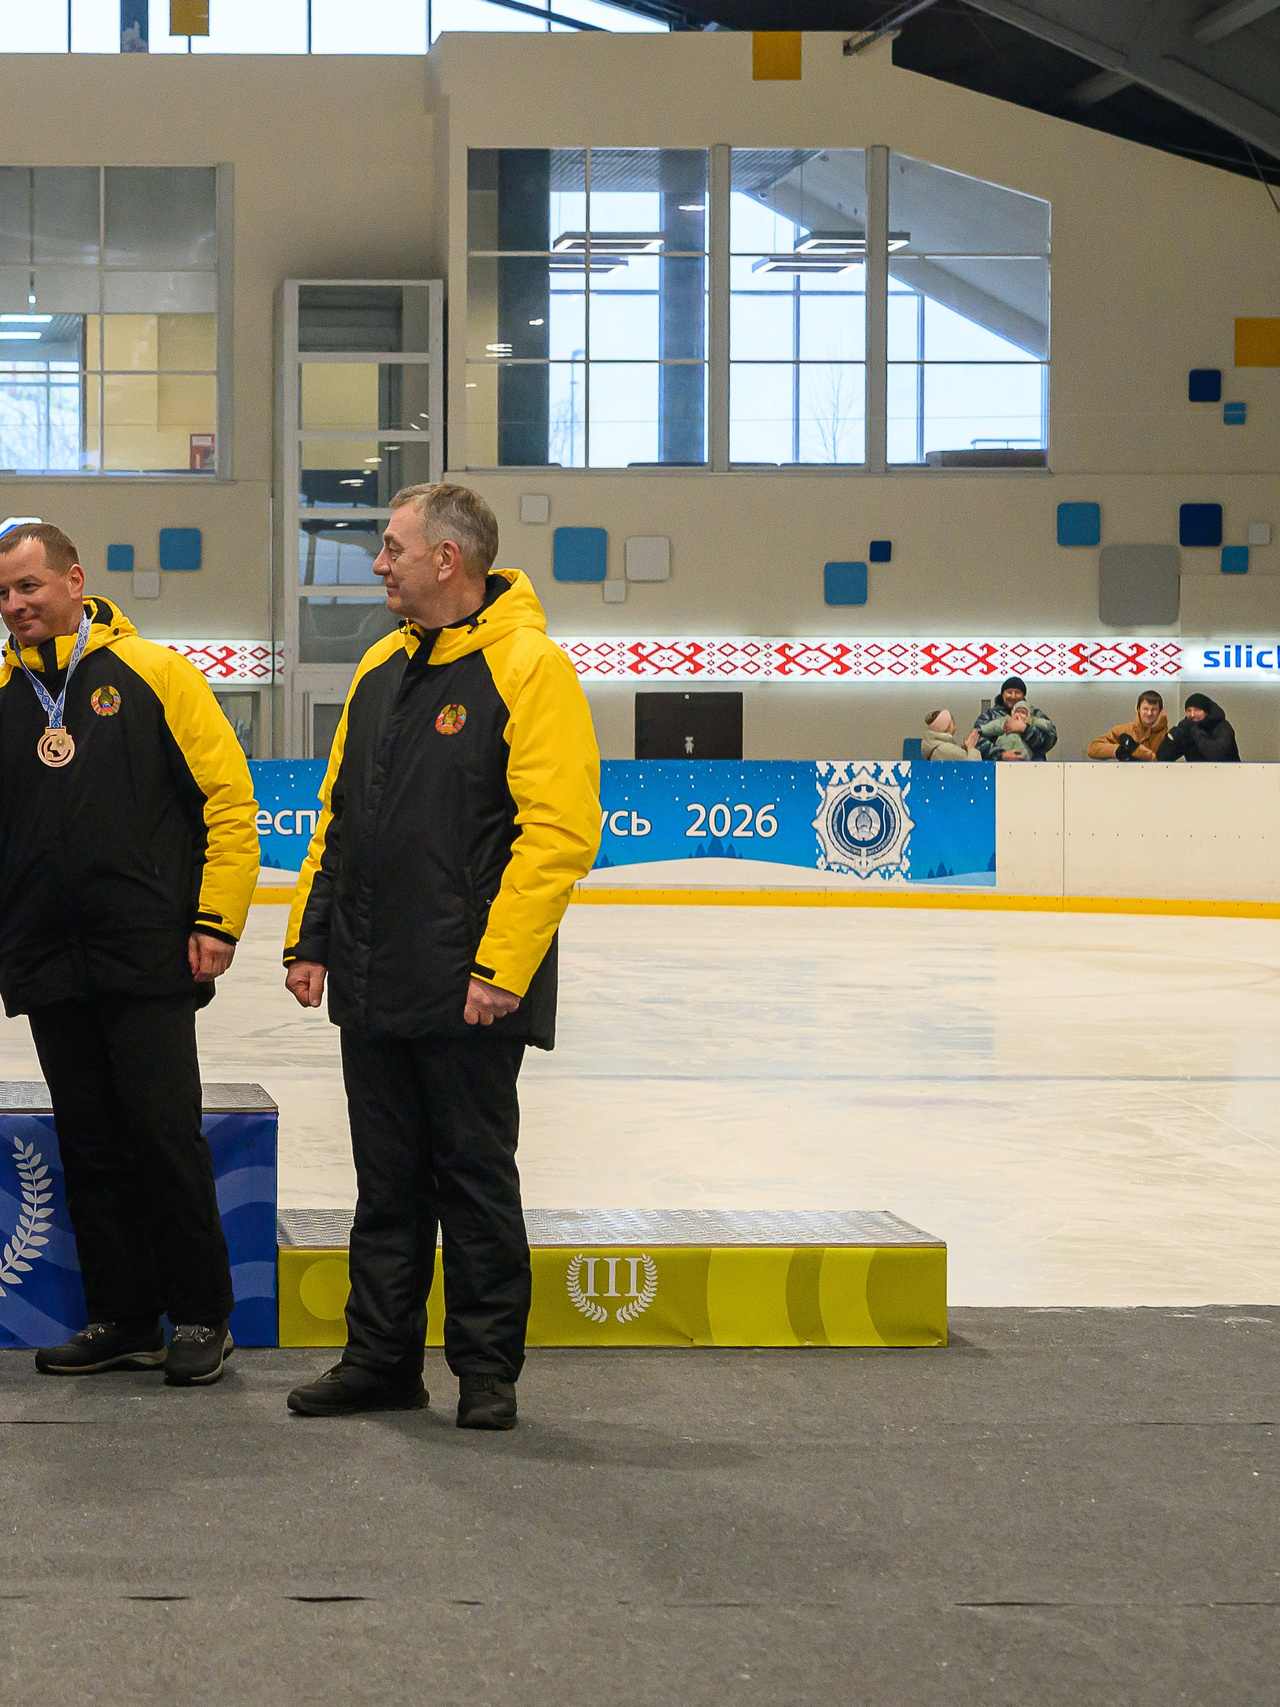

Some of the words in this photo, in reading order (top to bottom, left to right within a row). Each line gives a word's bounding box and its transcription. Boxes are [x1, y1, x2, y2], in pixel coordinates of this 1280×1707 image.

[1203, 644, 1280, 669] silic
[254, 809, 323, 836] есп
[685, 803, 779, 838] 2026
[582, 1257, 643, 1297] III
